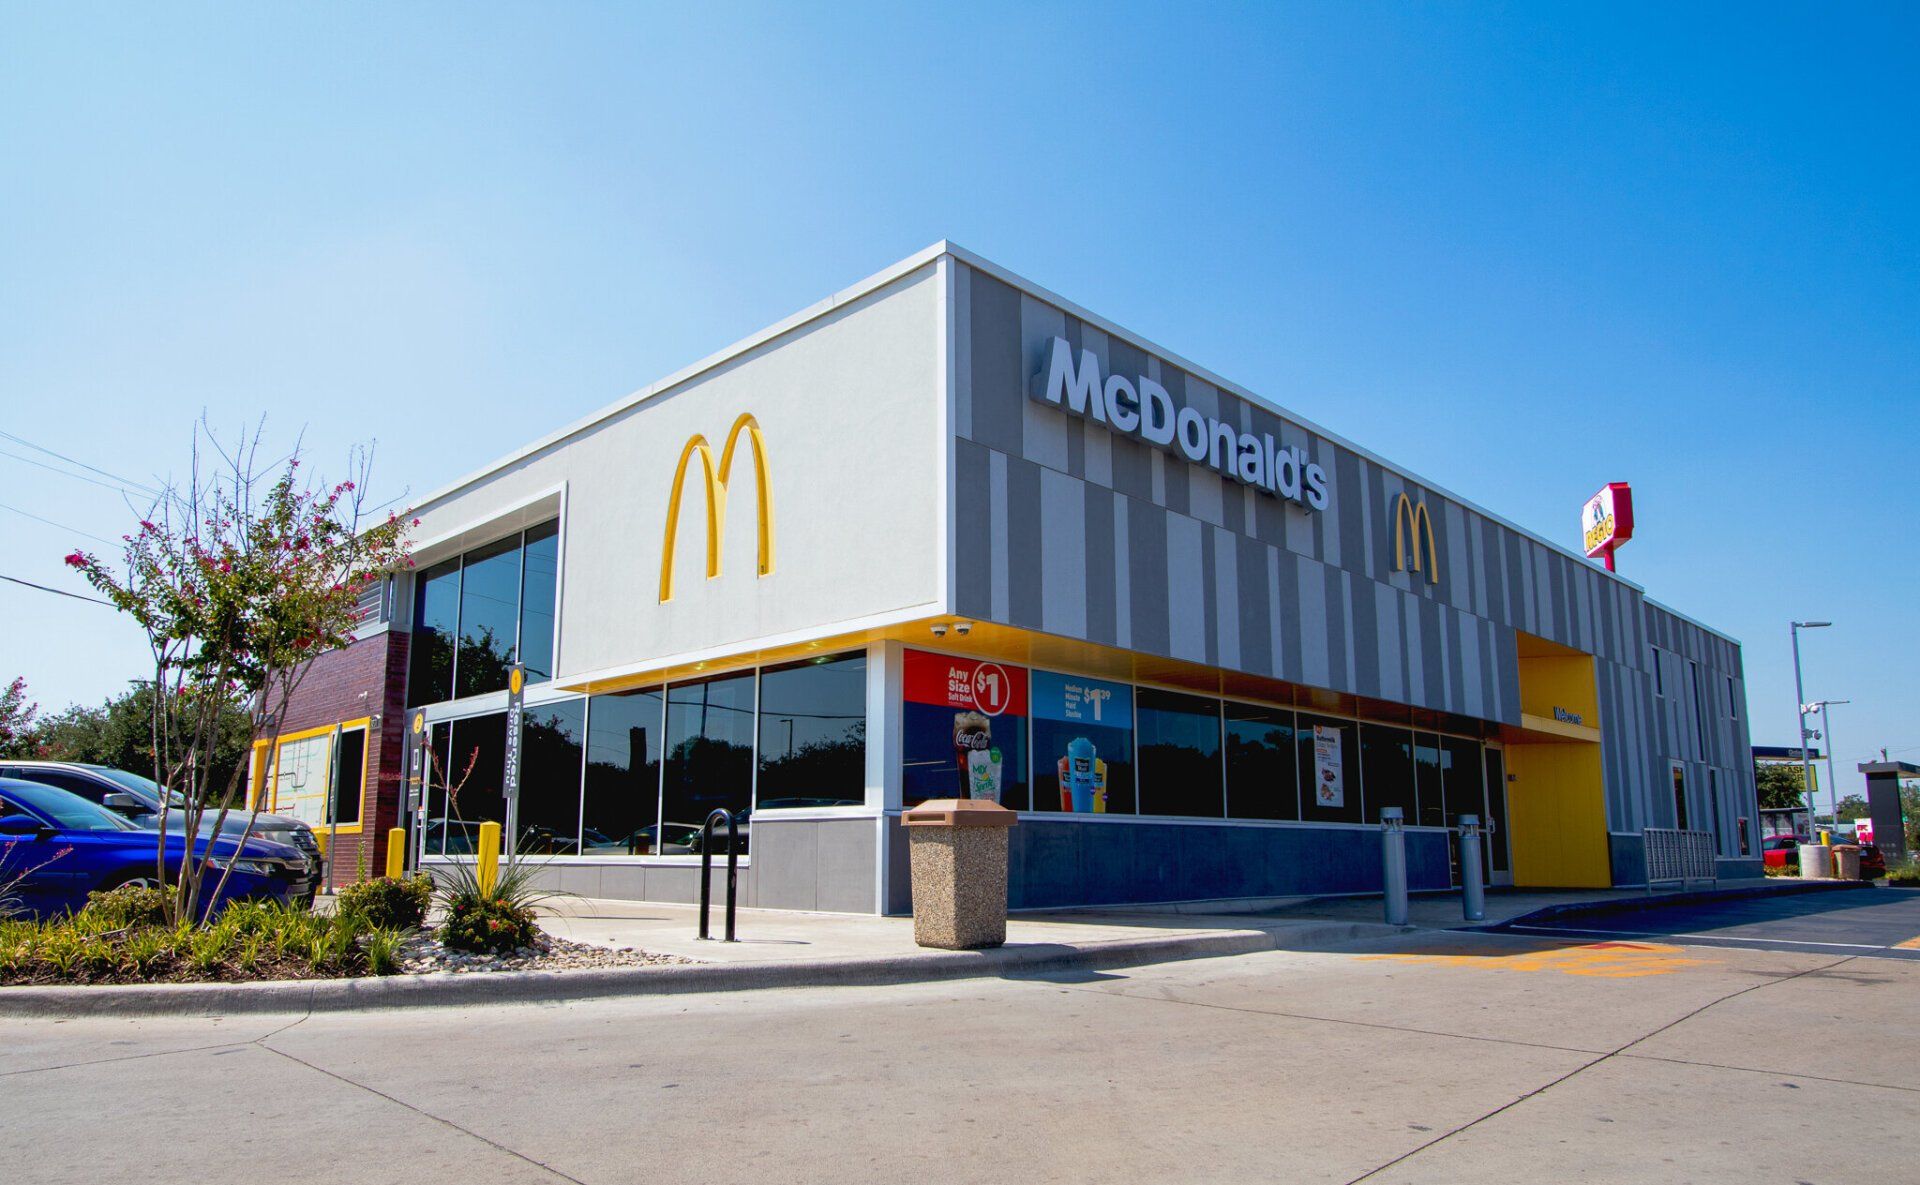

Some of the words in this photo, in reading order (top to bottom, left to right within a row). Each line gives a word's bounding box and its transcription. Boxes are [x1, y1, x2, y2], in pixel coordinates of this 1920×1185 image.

[1045, 336, 1330, 511] McDonald's
[948, 666, 969, 683] Any
[948, 680, 970, 693] Size
[976, 671, 999, 706] $1
[509, 702, 521, 788] Reserved
[956, 730, 990, 749] Coca-Cola
[505, 752, 513, 784] Thru
